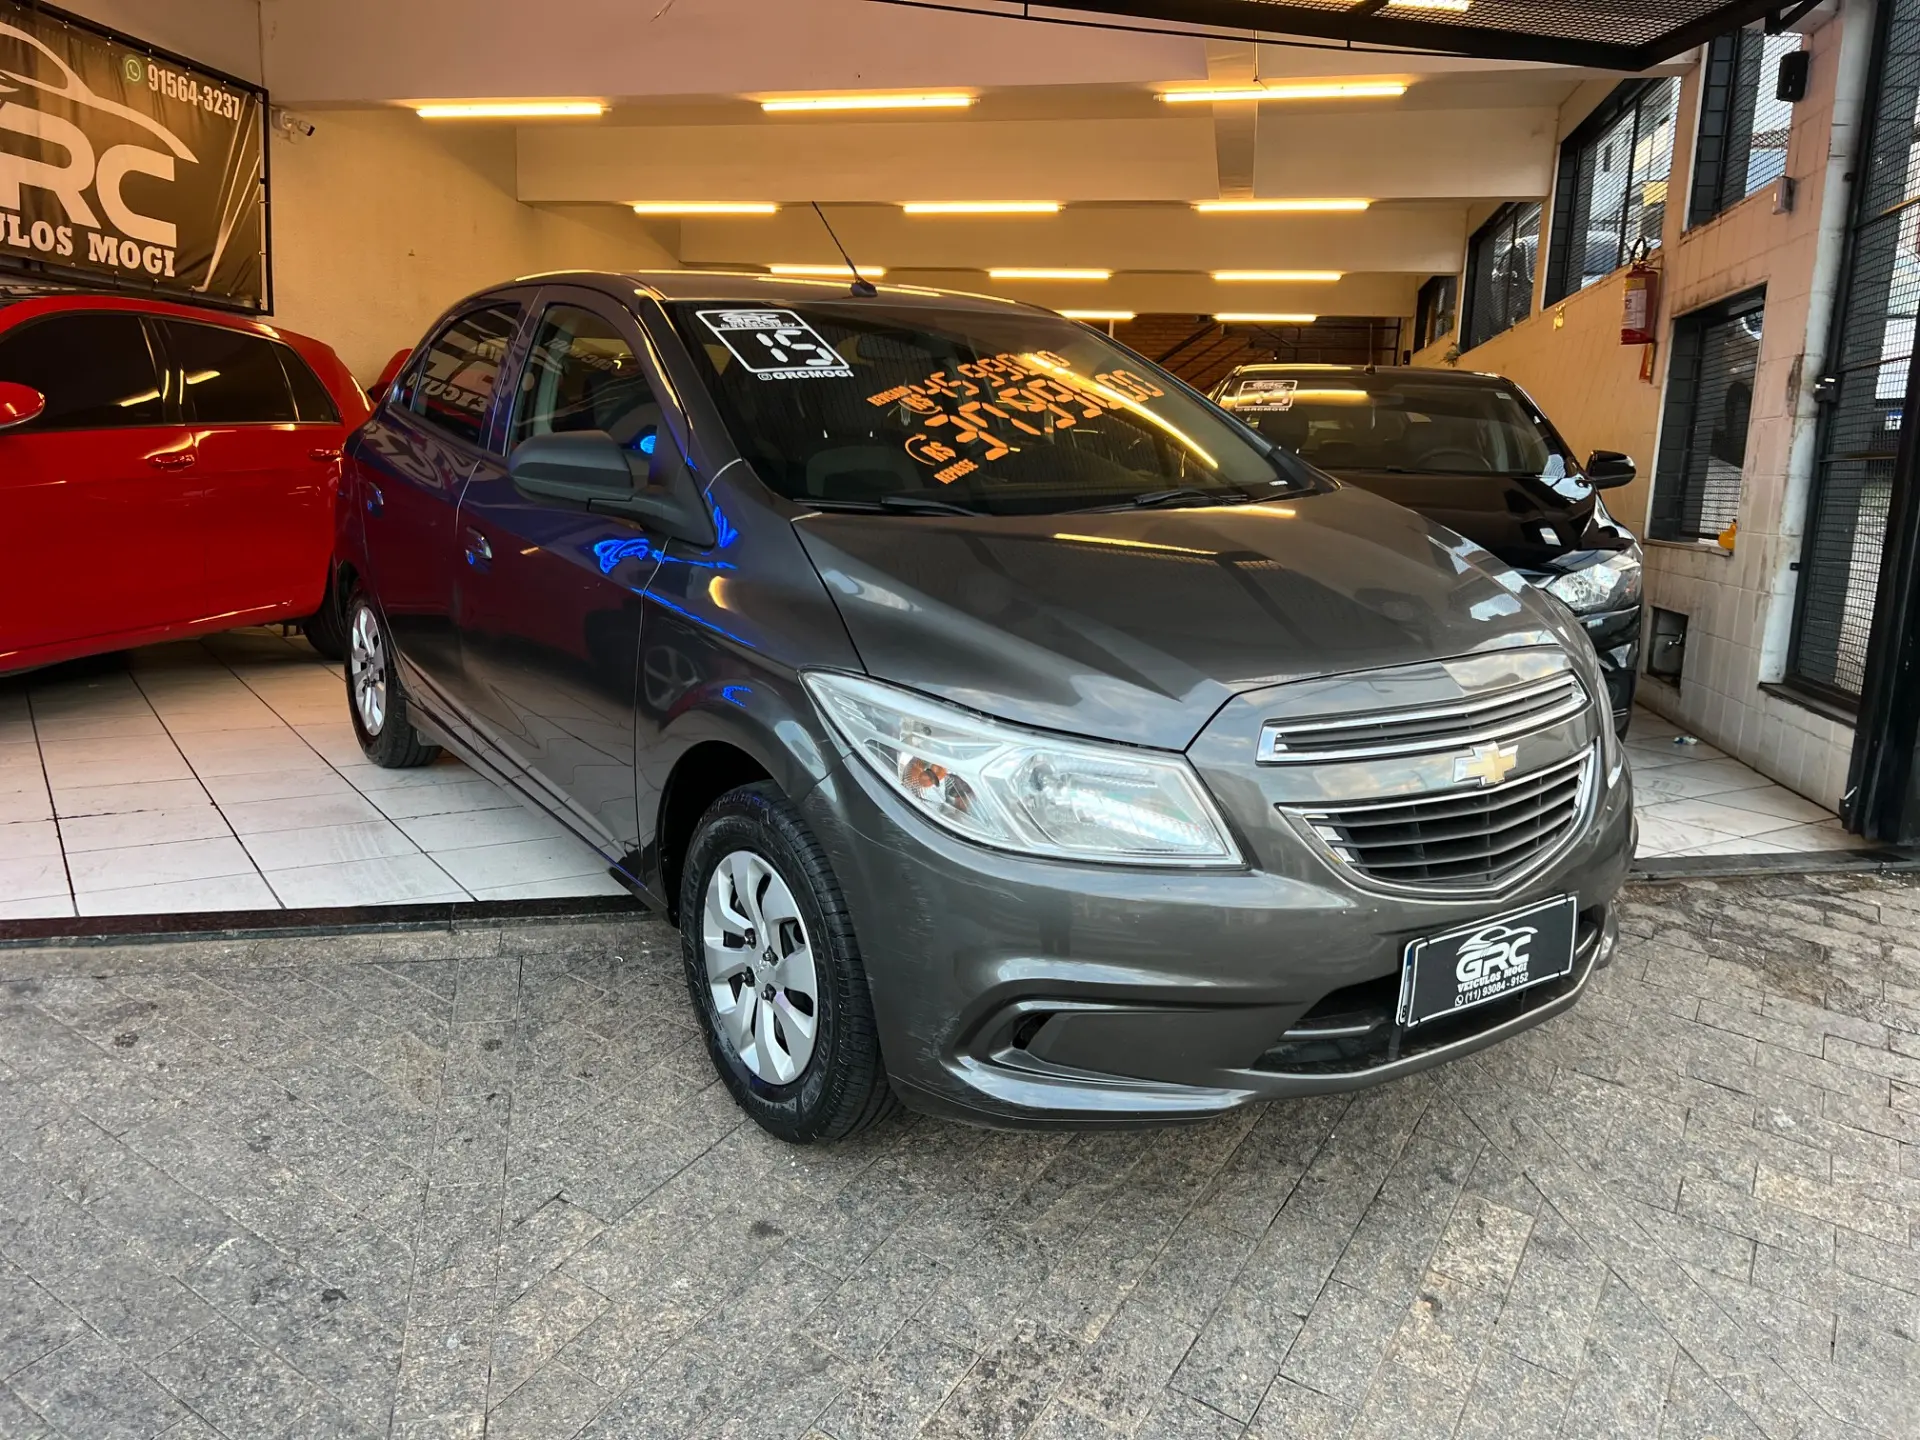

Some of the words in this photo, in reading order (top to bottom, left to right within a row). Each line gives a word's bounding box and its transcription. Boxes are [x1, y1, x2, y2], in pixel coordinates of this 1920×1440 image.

[147, 63, 240, 121] 91564-3237
[88, 231, 176, 278] MOGI
[755, 329, 834, 366] 15
[1455, 933, 1532, 982] GRC
[1457, 973, 1502, 993] VEICULOS
[1503, 962, 1528, 978] MOGI
[1464, 990, 1481, 1005] (11)
